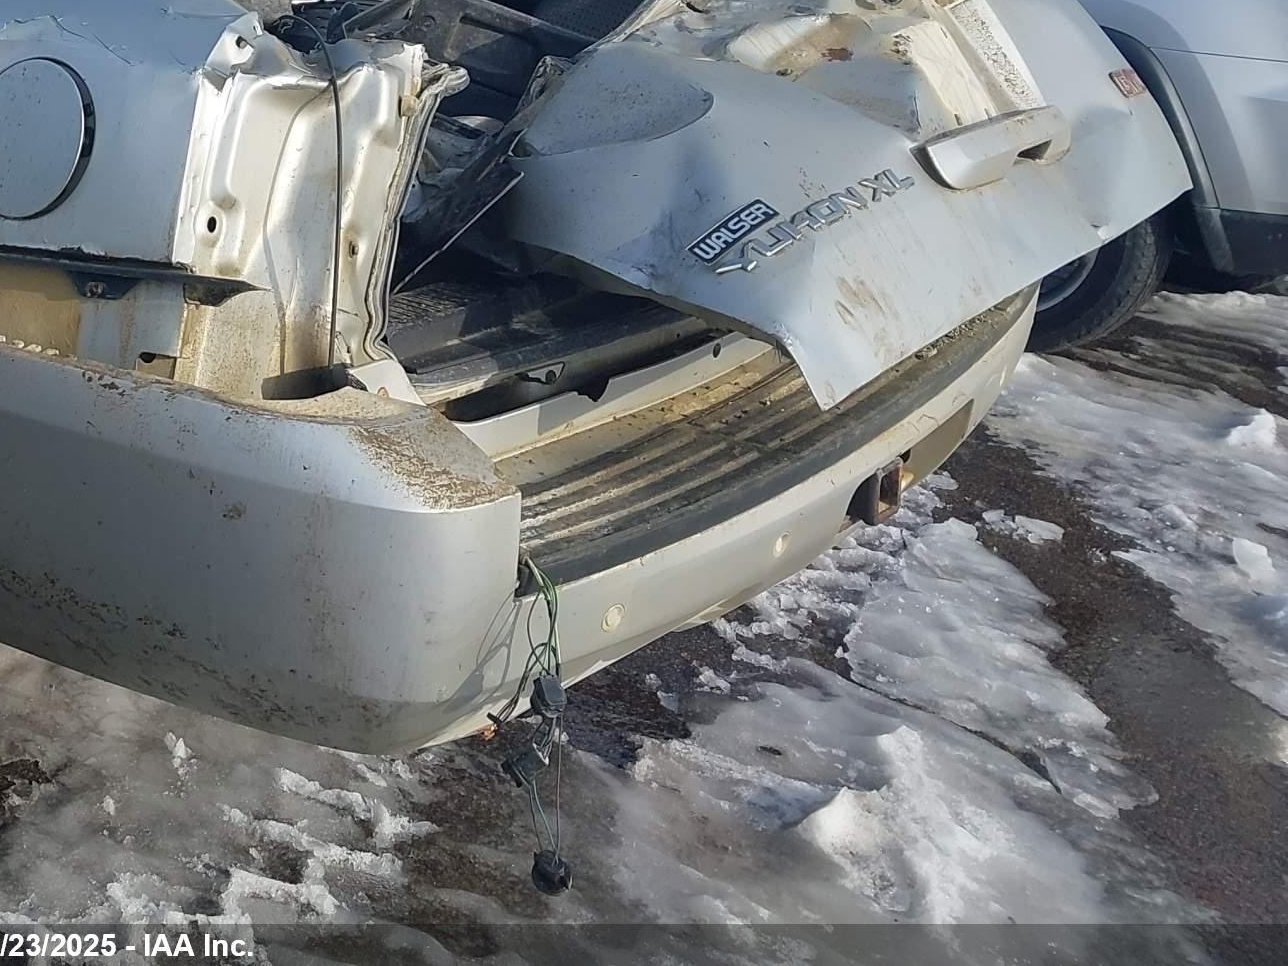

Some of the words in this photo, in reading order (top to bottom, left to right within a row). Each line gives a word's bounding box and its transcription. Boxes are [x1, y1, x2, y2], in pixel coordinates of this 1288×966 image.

[693, 203, 775, 260] WALSER
[715, 186, 868, 274] YUKON
[856, 168, 915, 203] XL
